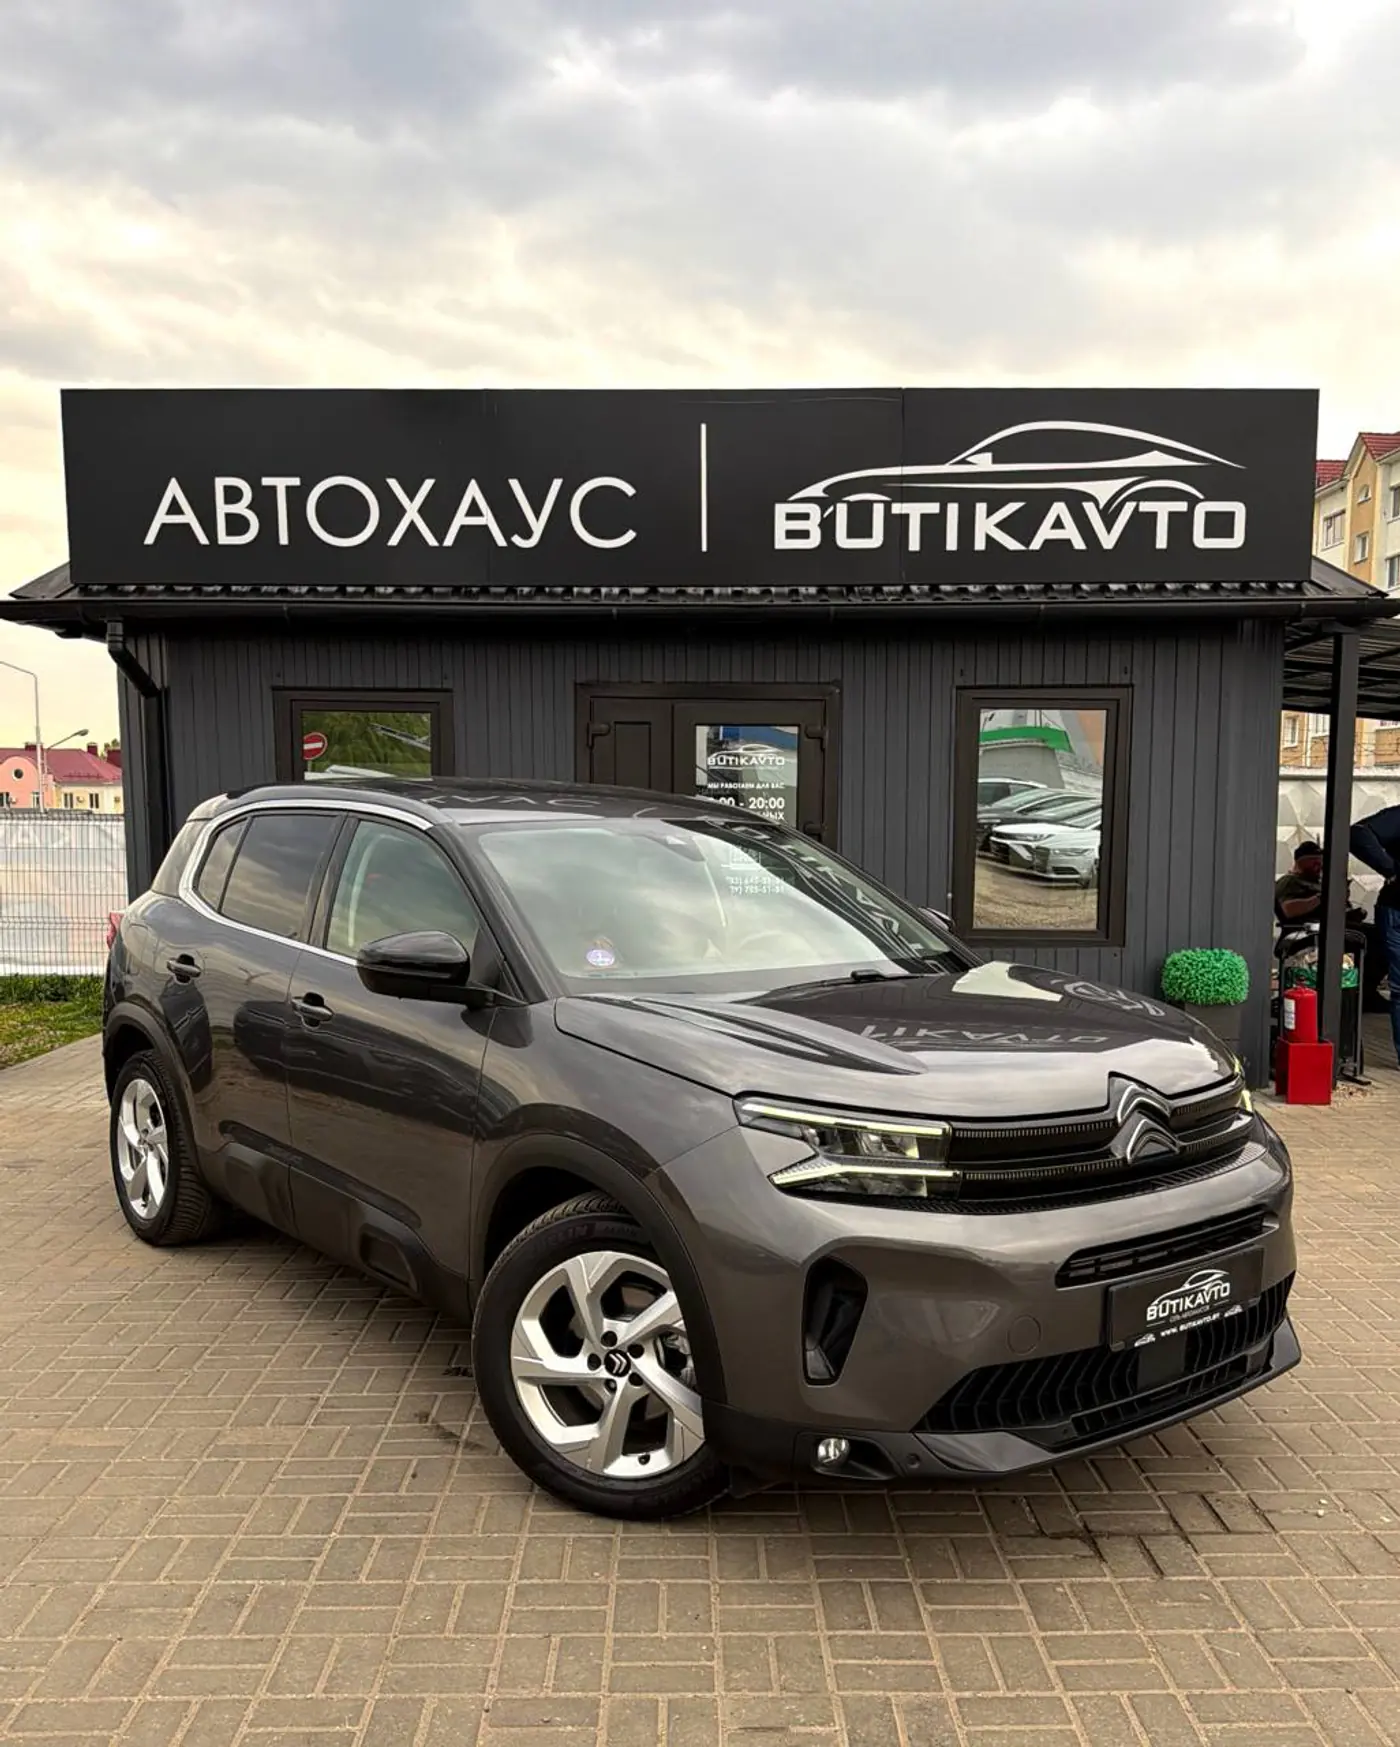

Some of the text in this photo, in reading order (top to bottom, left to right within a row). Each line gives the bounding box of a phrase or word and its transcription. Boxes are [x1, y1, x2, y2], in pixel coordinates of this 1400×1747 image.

[144, 475, 637, 549] АВТОХАУС
[773, 500, 1247, 551] BUTIKAVTO
[707, 755, 785, 766] BUTIKAVTO
[748, 797, 785, 809] 20:00
[1146, 1283, 1231, 1321] BUTIKAVTO
